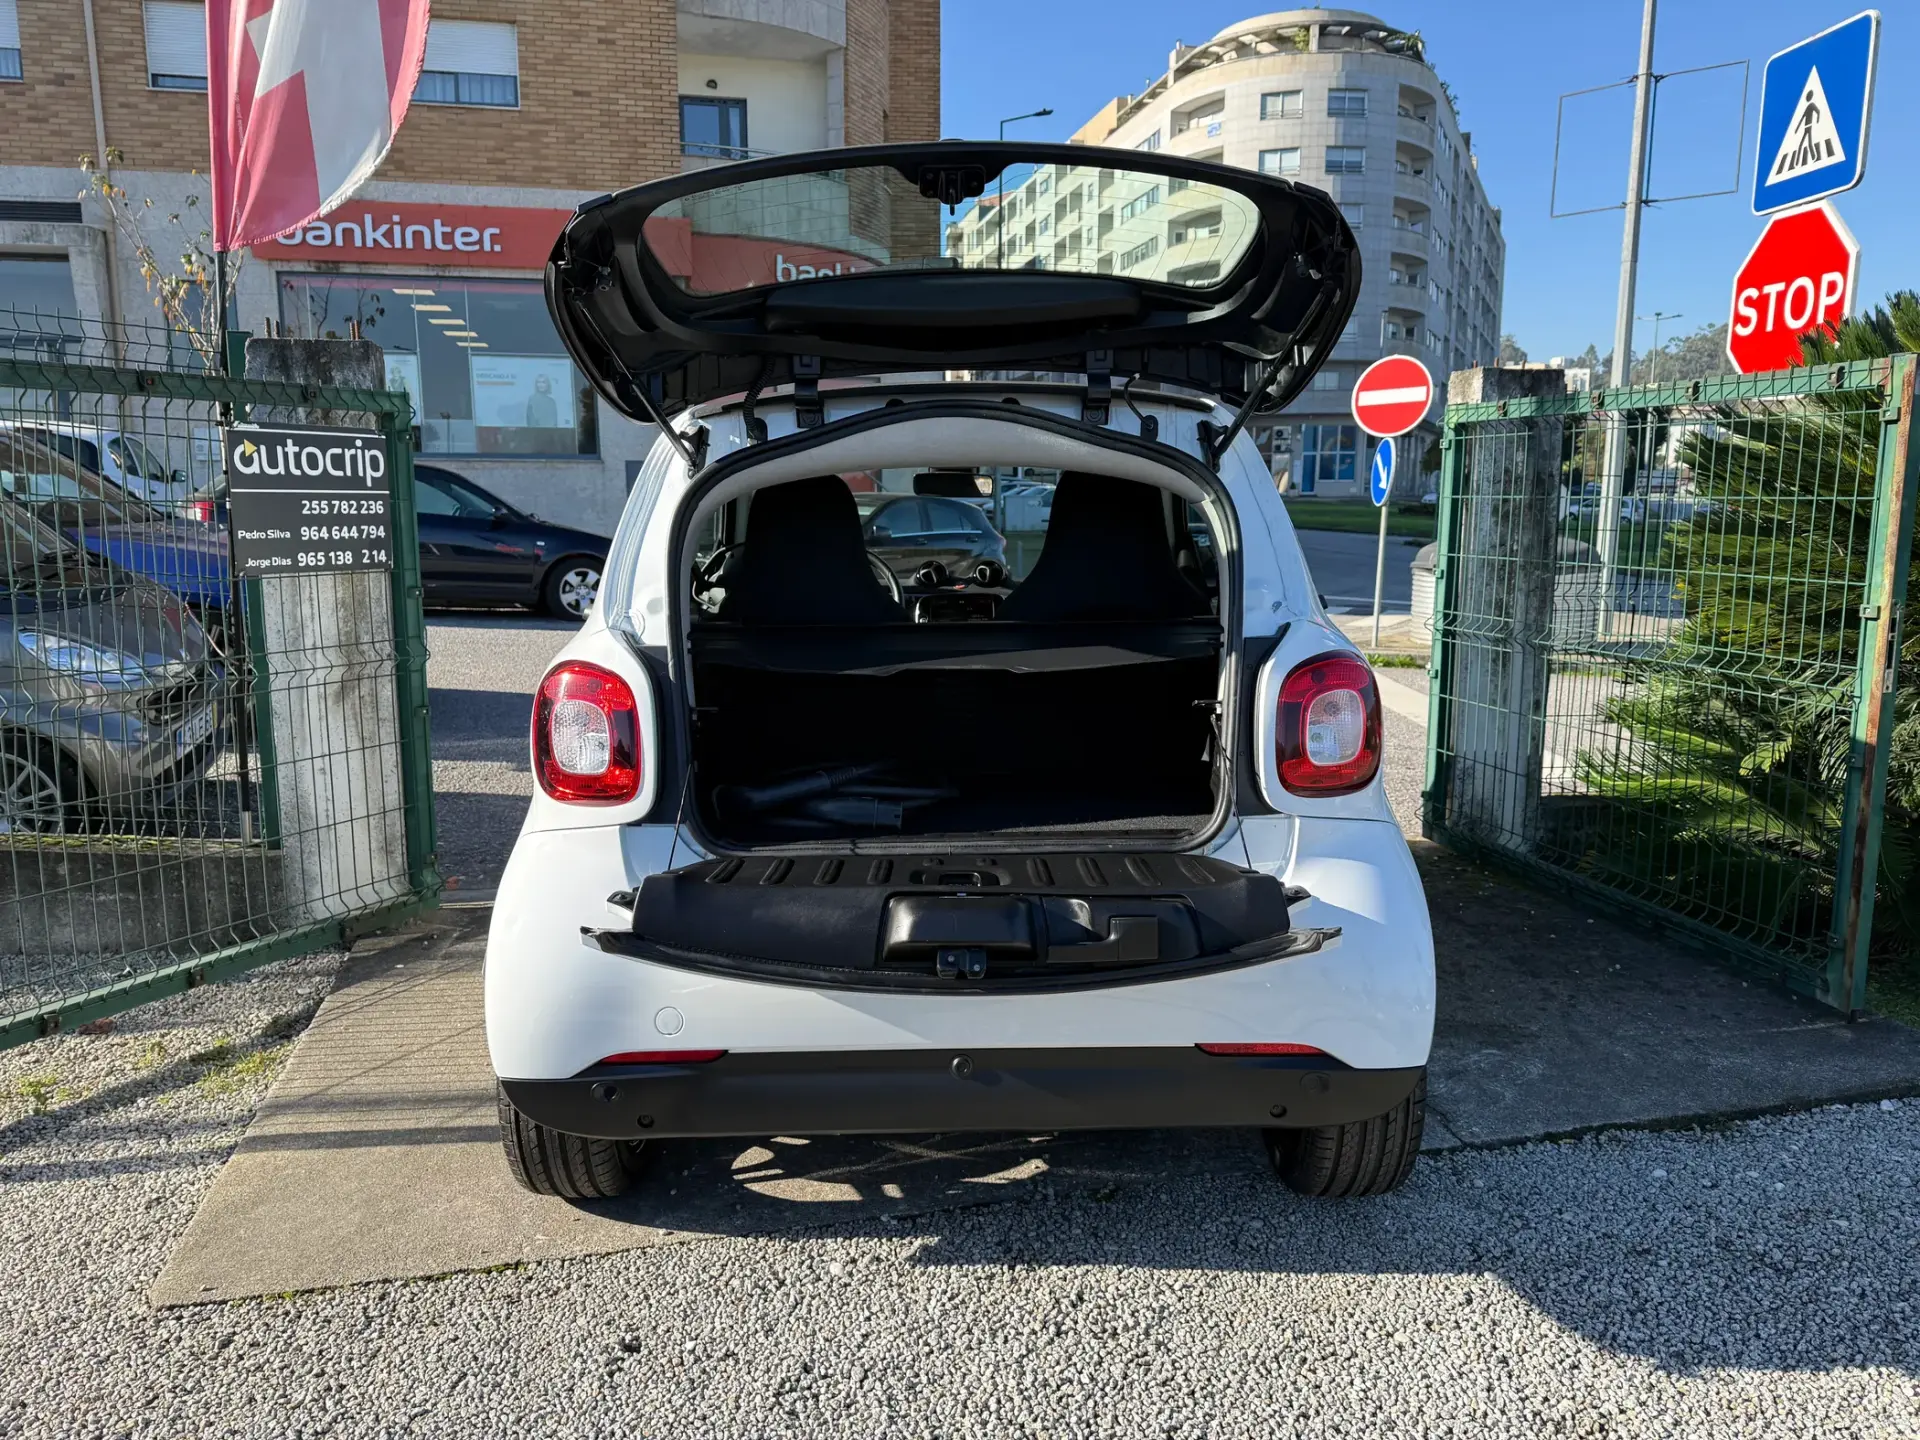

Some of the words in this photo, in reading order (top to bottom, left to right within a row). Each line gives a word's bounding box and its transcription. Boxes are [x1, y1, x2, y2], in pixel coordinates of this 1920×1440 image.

[1734, 271, 1844, 337] STOP
[233, 438, 385, 487] autocrip
[301, 500, 329, 515] 255
[331, 500, 358, 515] 782
[360, 500, 384, 515] 236
[238, 529, 267, 540] Pedro
[267, 529, 291, 539] Silva
[300, 526, 329, 541] 964
[331, 526, 359, 541] 644
[360, 525, 386, 540] 794
[245, 557, 271, 568] Jorge
[272, 557, 292, 567] Dias
[297, 552, 325, 567] 965
[328, 551, 353, 566] 138
[361, 549, 387, 564] 214
